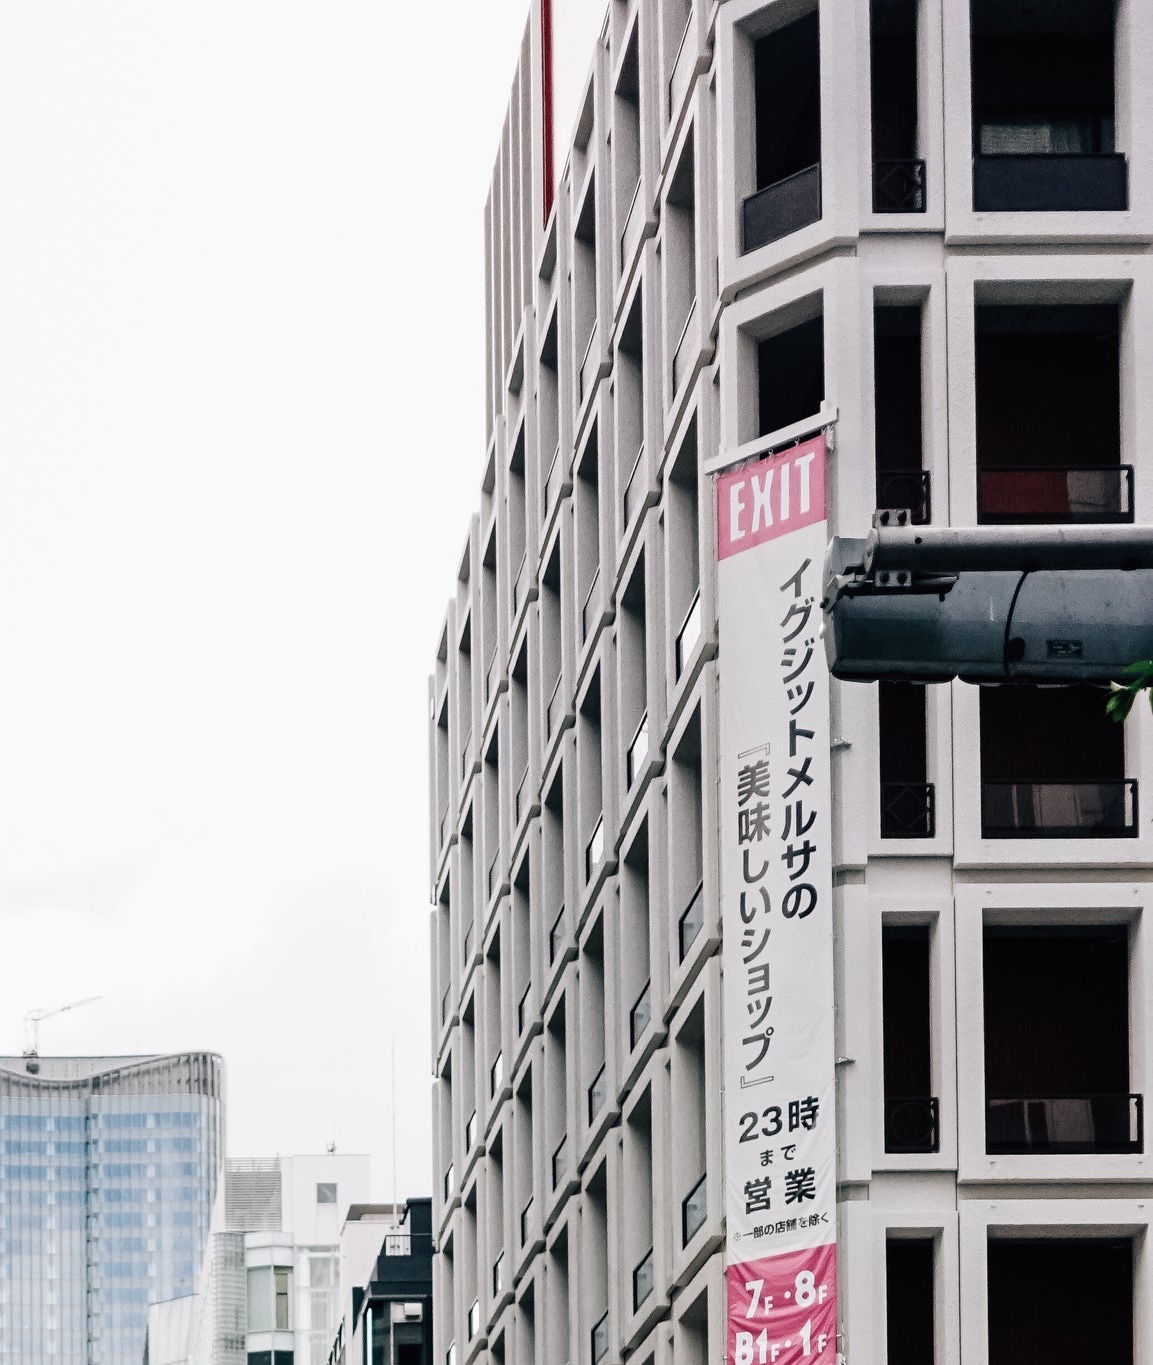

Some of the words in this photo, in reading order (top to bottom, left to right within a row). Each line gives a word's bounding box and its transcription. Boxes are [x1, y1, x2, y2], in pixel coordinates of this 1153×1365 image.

[729, 452, 817, 543] EXIT
[778, 557, 819, 920] イグジットメルサの
[738, 1095, 820, 1144] 23時
[759, 1144, 797, 1167] まで
[743, 1167, 817, 1215] 営業
